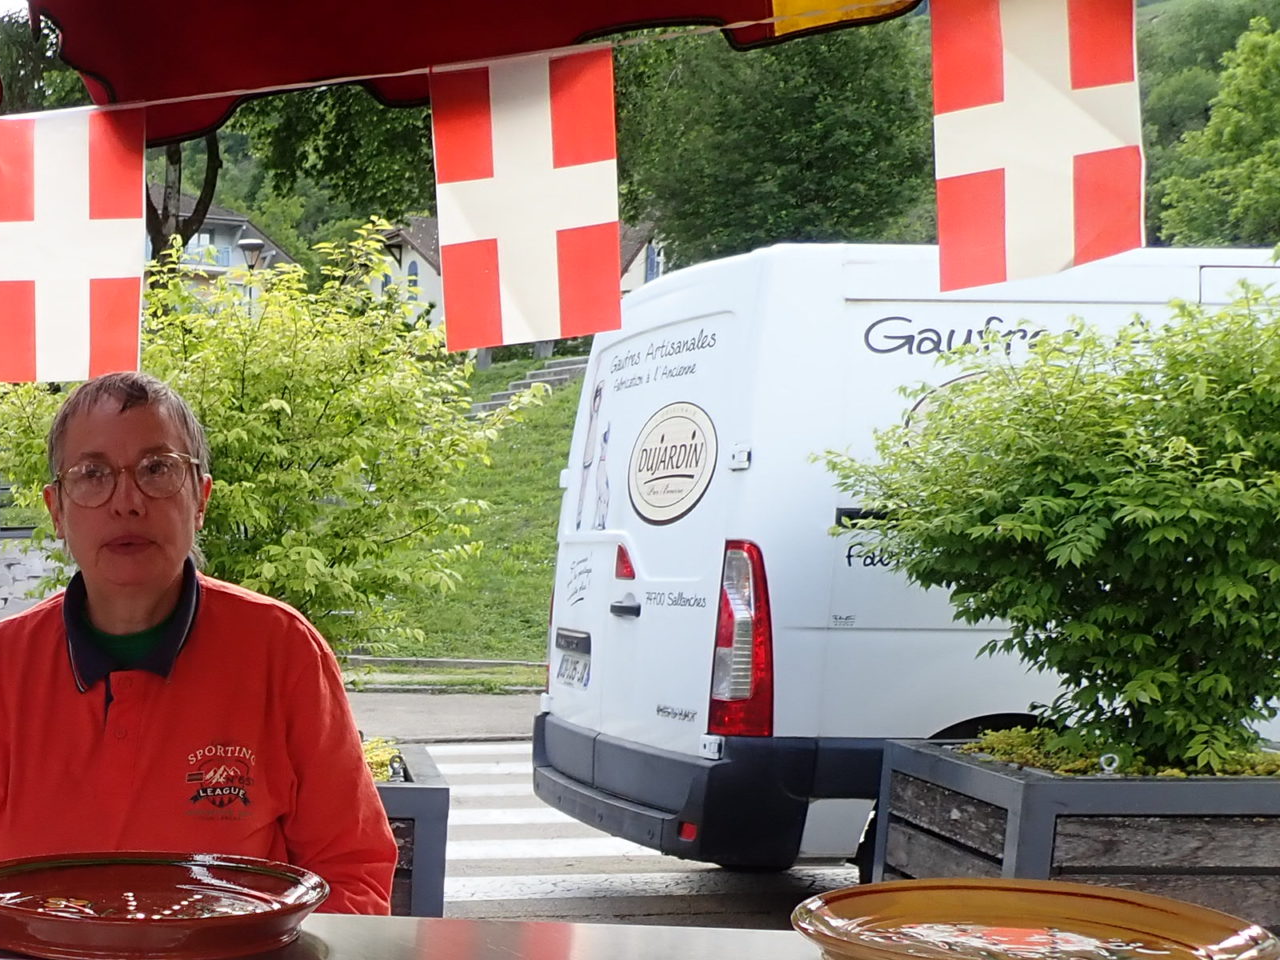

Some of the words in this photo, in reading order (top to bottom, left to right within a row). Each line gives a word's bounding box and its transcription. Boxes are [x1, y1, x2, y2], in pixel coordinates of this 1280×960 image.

[645, 328, 716, 360] Artisanales
[864, 316, 1080, 356] Gaufr
[667, 592, 706, 608] Sallanches
[200, 787, 245, 798] LEAGUE
